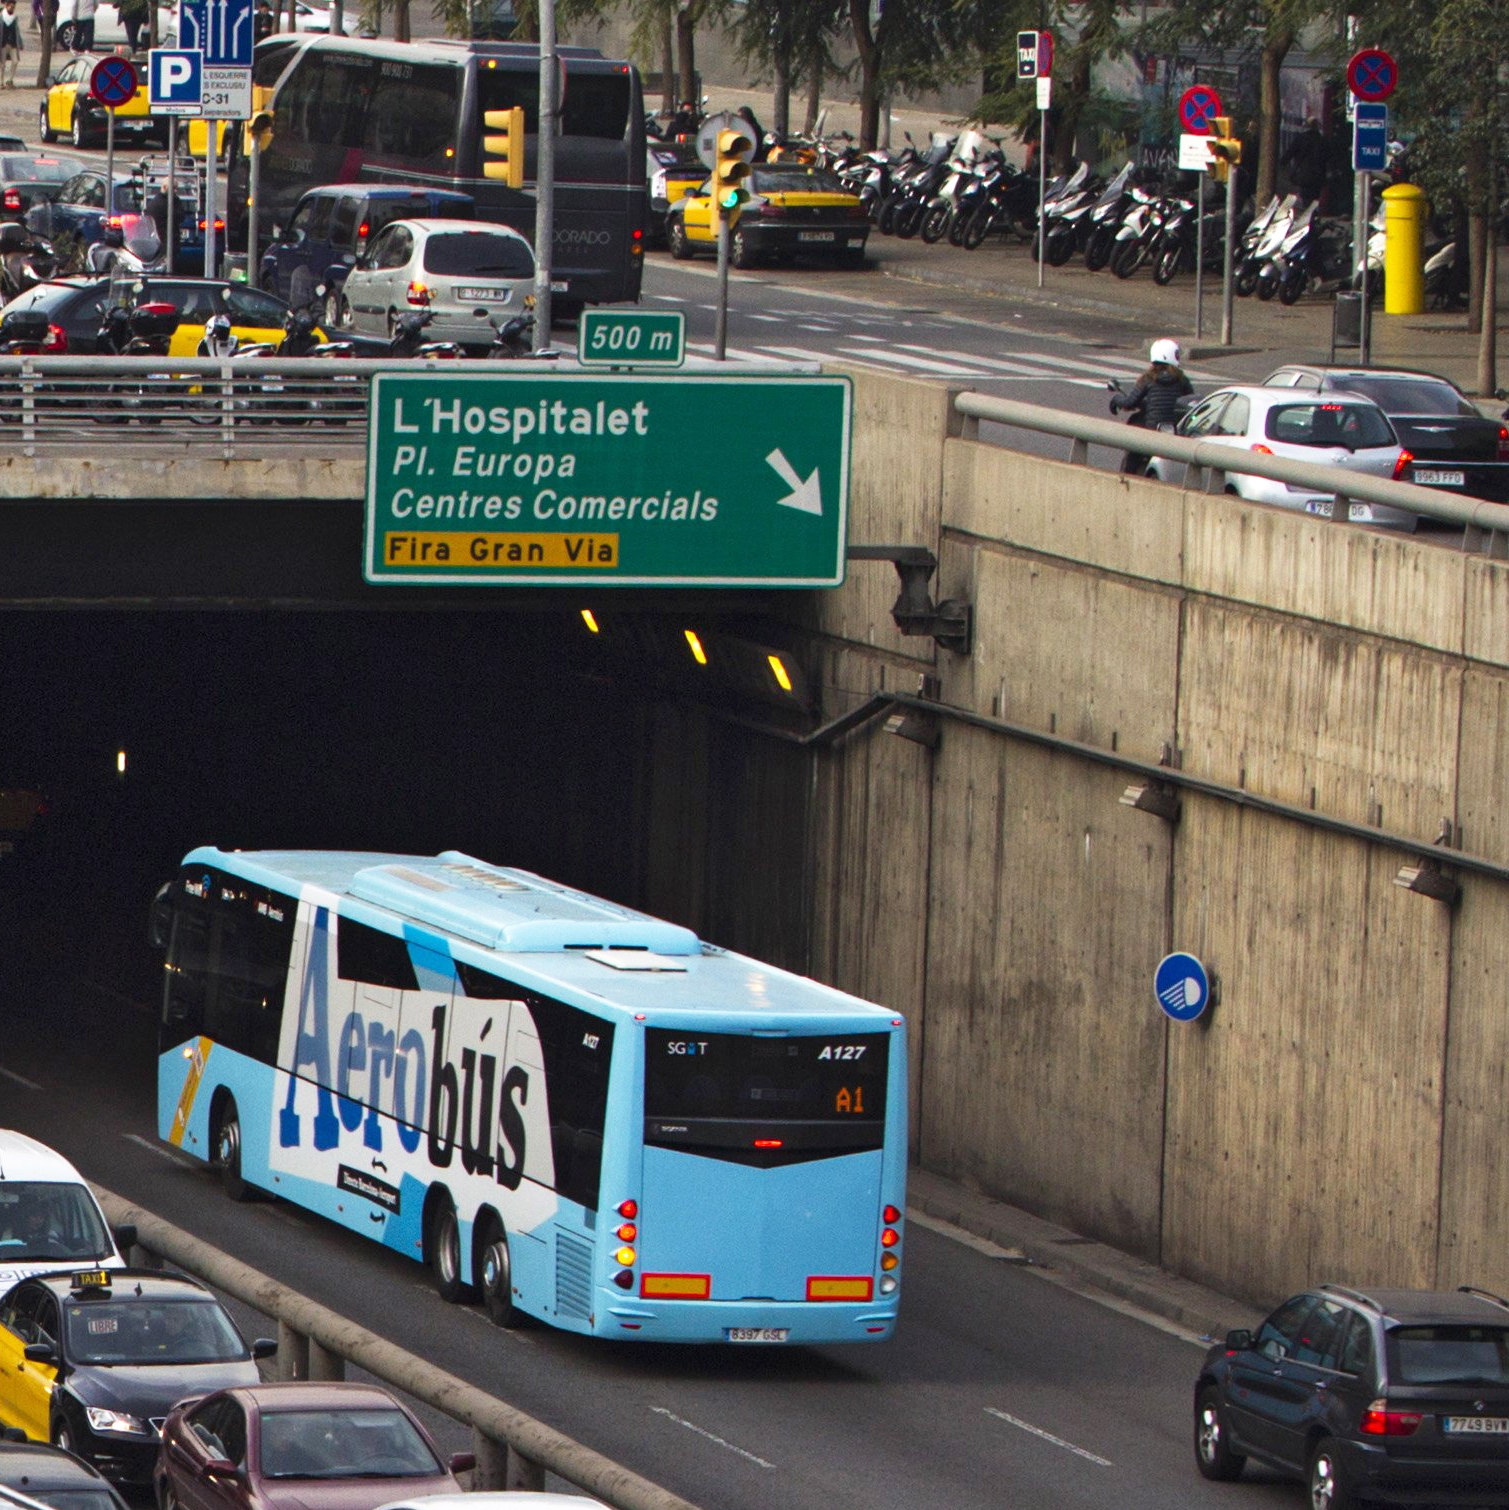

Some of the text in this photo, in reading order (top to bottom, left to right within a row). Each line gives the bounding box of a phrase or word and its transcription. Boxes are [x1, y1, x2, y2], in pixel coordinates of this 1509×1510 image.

[160, 56, 192, 98] P
[1362, 147, 1381, 156] TAXI
[590, 324, 673, 351] 500 m
[392, 445, 577, 485] Pl. Europa
[390, 487, 719, 521] Centres Comercials
[388, 537, 614, 563] Fira Gran Via
[279, 905, 530, 1192] Aerobús
[817, 1045, 867, 1060] A127
[835, 1086, 864, 1113] A1
[80, 1273, 100, 1286] TAXI
[90, 1319, 118, 1333] LIBRE
[1452, 1418, 1483, 1431] 7749
